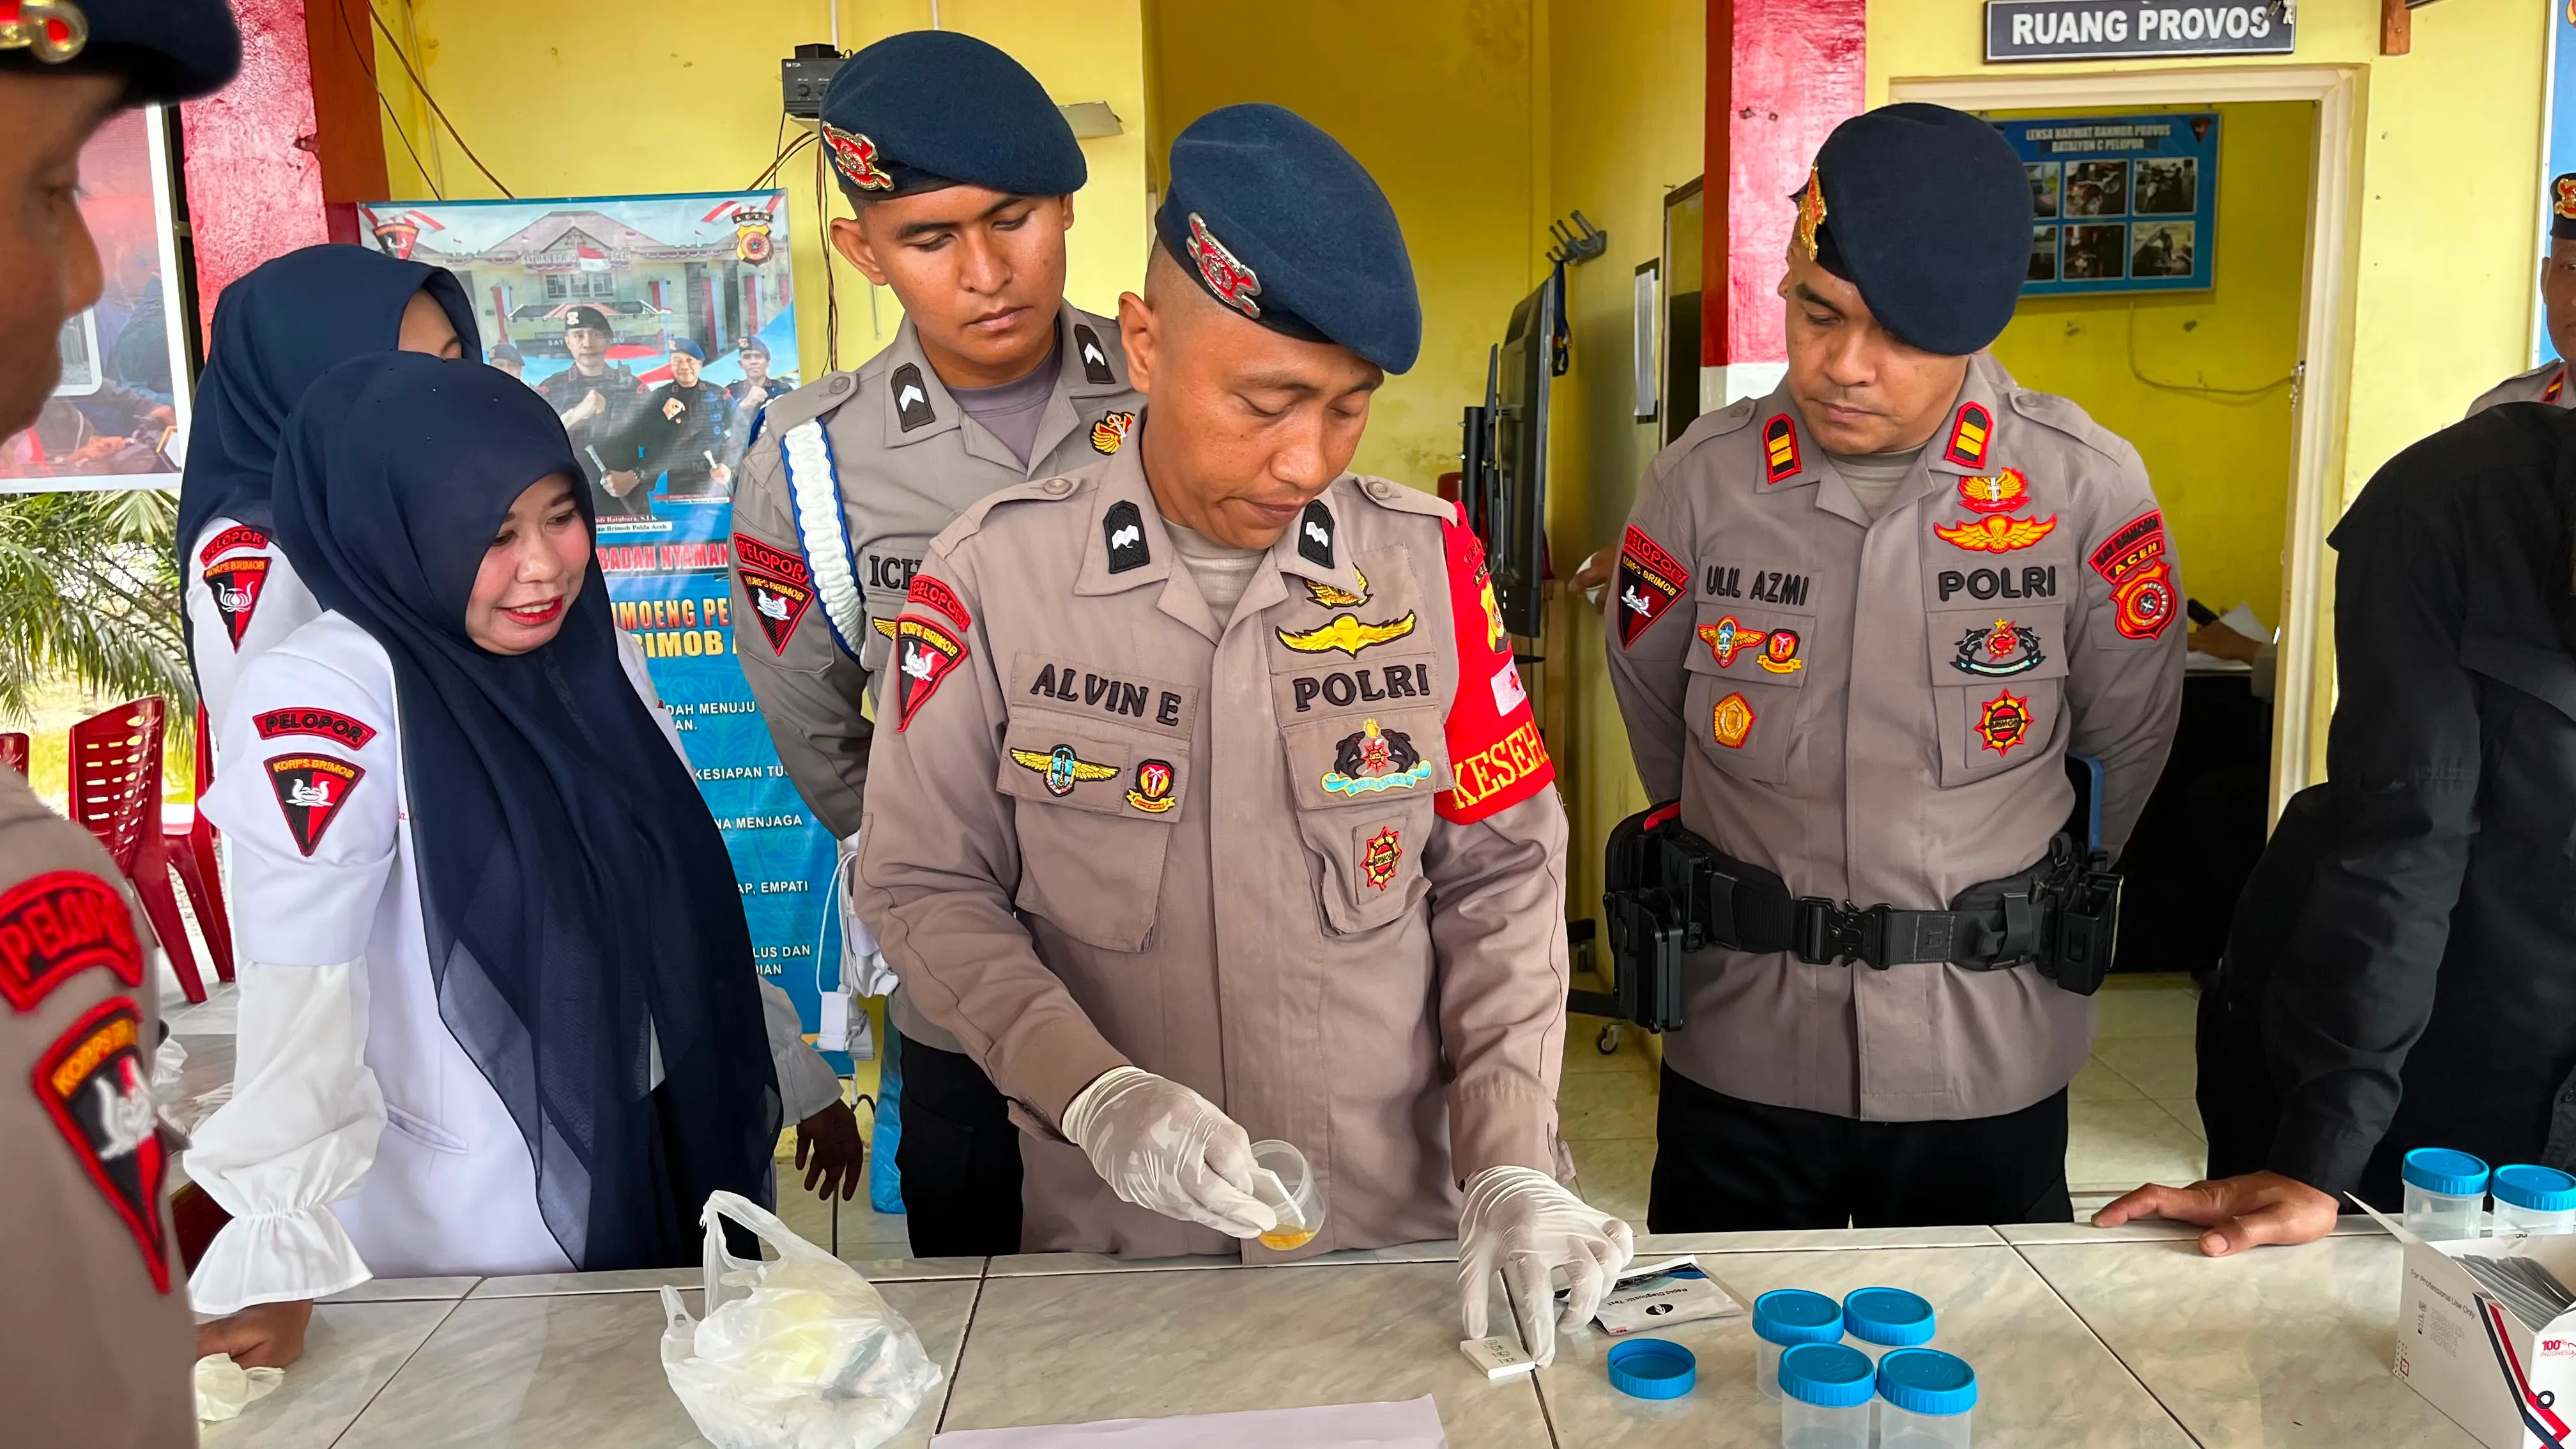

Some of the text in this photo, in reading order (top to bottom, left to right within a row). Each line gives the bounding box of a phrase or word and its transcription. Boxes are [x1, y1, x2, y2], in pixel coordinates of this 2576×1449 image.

[2012, 6, 2271, 45] RUANG PROVOS
[521, 255, 551, 265] SATUAN
[610, 251, 631, 262] ACEH
[230, 561, 264, 572] BRIMOB
[738, 540, 805, 581] PELOPOR
[2115, 543, 2157, 575] ACEH
[769, 581, 805, 601] BRIMOB
[1643, 570, 1676, 596] BRIMOB
[1706, 565, 1809, 606] ULIL AZMI
[1938, 566, 2056, 602] POLRI
[914, 581, 966, 624] PELOPOR
[922, 627, 958, 657] BRIMOB
[1029, 663, 1181, 726] ALVIN E
[1292, 663, 1430, 712] POLRI
[699, 701, 756, 715] MENUJU
[265, 712, 363, 742] PELOPOR
[273, 758, 355, 779] KORPS BRIMOB
[696, 766, 762, 781] KESIAPAN
[736, 815, 803, 829] MENJAGA
[760, 880, 809, 893] EMPATI
[783, 945, 811, 957] DAN
[1607, 1287, 1688, 1307] Rapid Diagnostic Test
[2419, 1275, 2451, 1302] Professional
[2451, 1297, 2462, 1310] Use
[2462, 1305, 2476, 1320] Only
